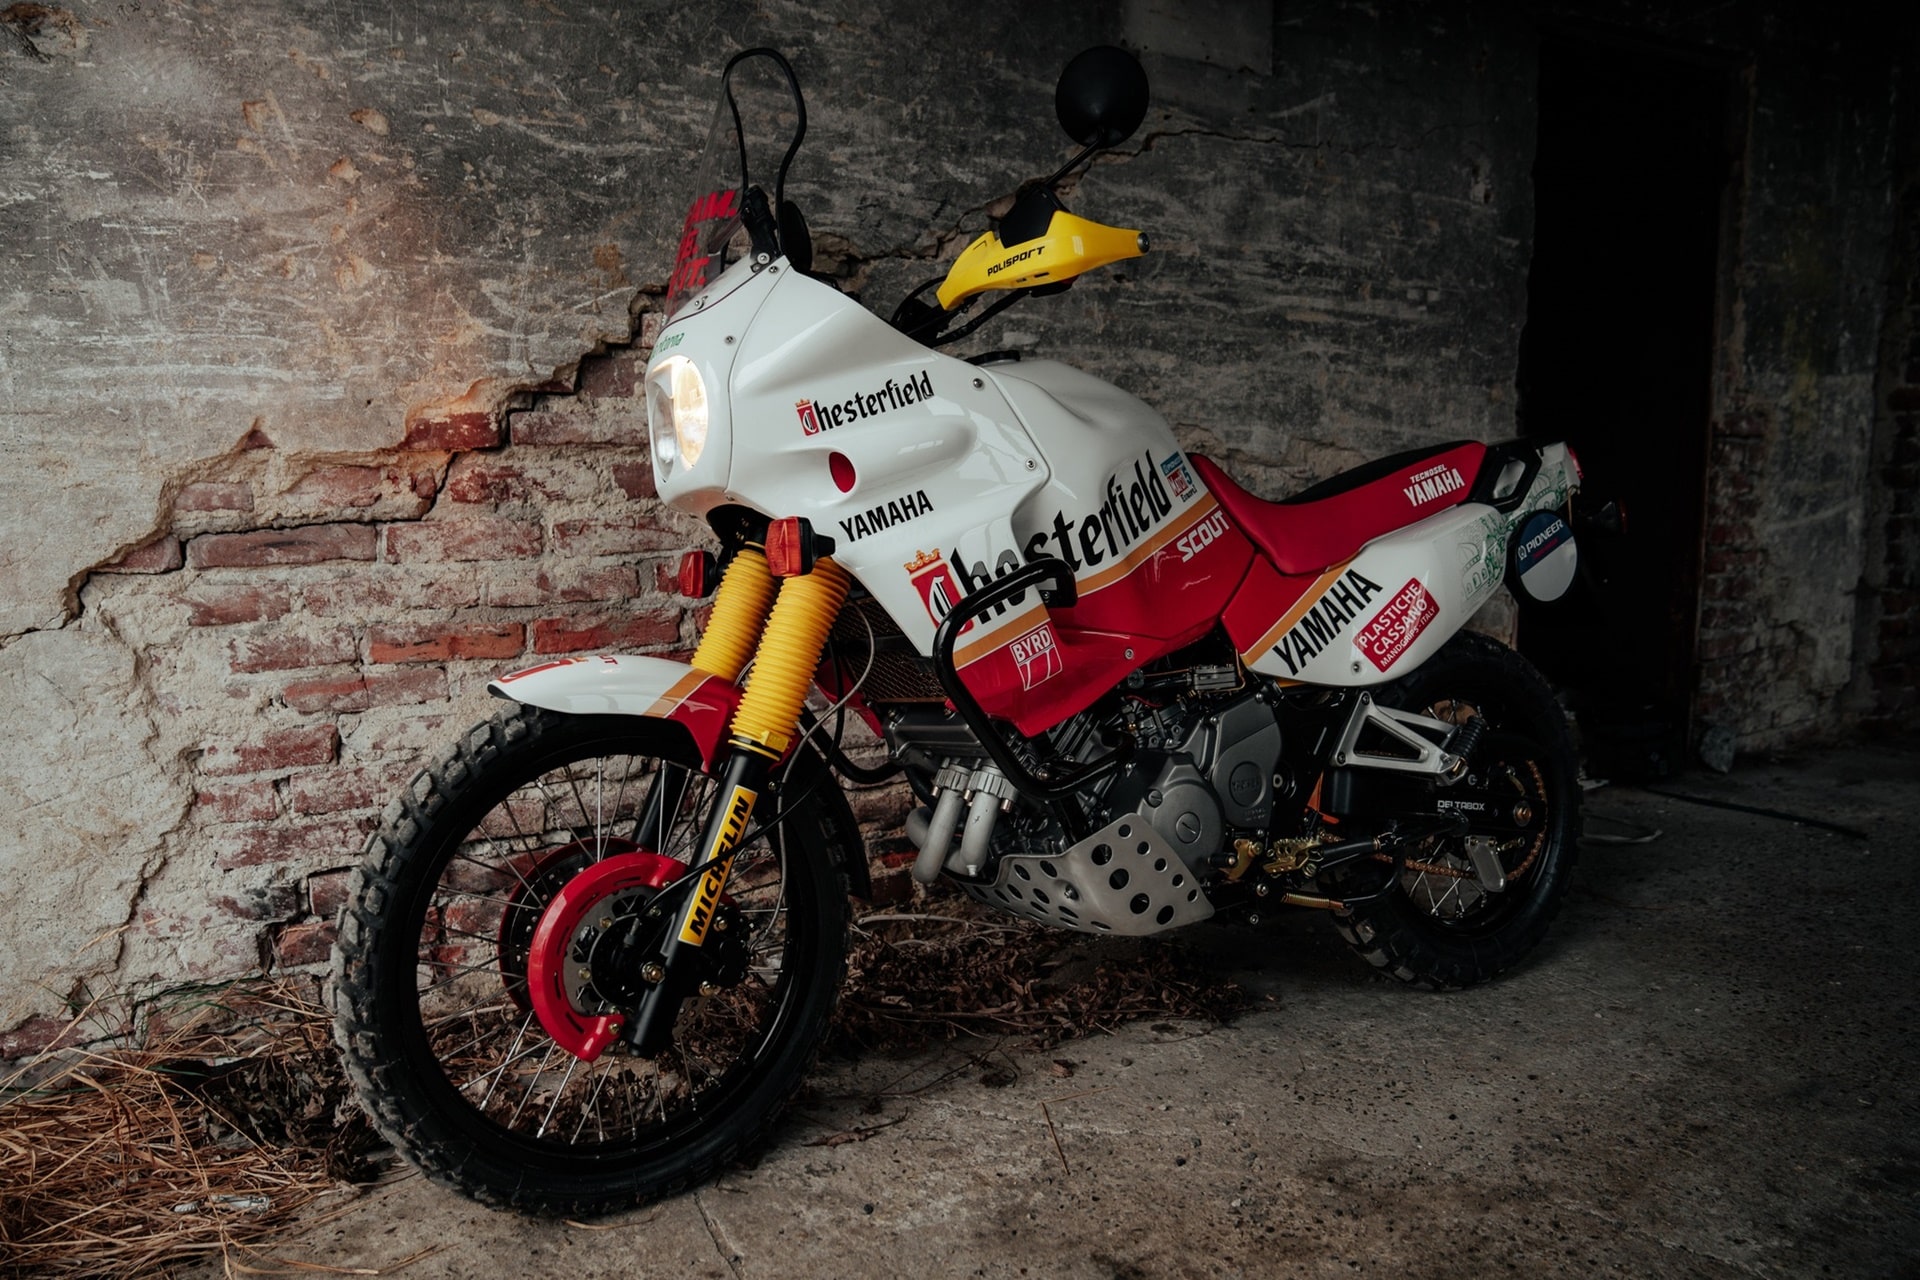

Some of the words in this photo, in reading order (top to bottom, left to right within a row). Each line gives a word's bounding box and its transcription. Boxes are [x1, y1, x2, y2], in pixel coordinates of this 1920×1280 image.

[987, 246, 1045, 276] POLISPORT
[803, 369, 935, 433] Chesterfield
[1403, 468, 1465, 507] YAMAHA
[1410, 464, 1447, 484] TECNOSEL
[839, 490, 934, 543] YAMAHA
[1176, 510, 1229, 563] SCOUT
[1526, 519, 1563, 553] PIONEER
[1272, 568, 1383, 677] YAMAHA
[1358, 583, 1422, 649] PLASTICHE
[1373, 598, 1428, 655] CASSANO
[1420, 605, 1437, 627] ITALY
[1012, 629, 1051, 662] BYRD
[689, 795, 750, 937] MICHELIN
